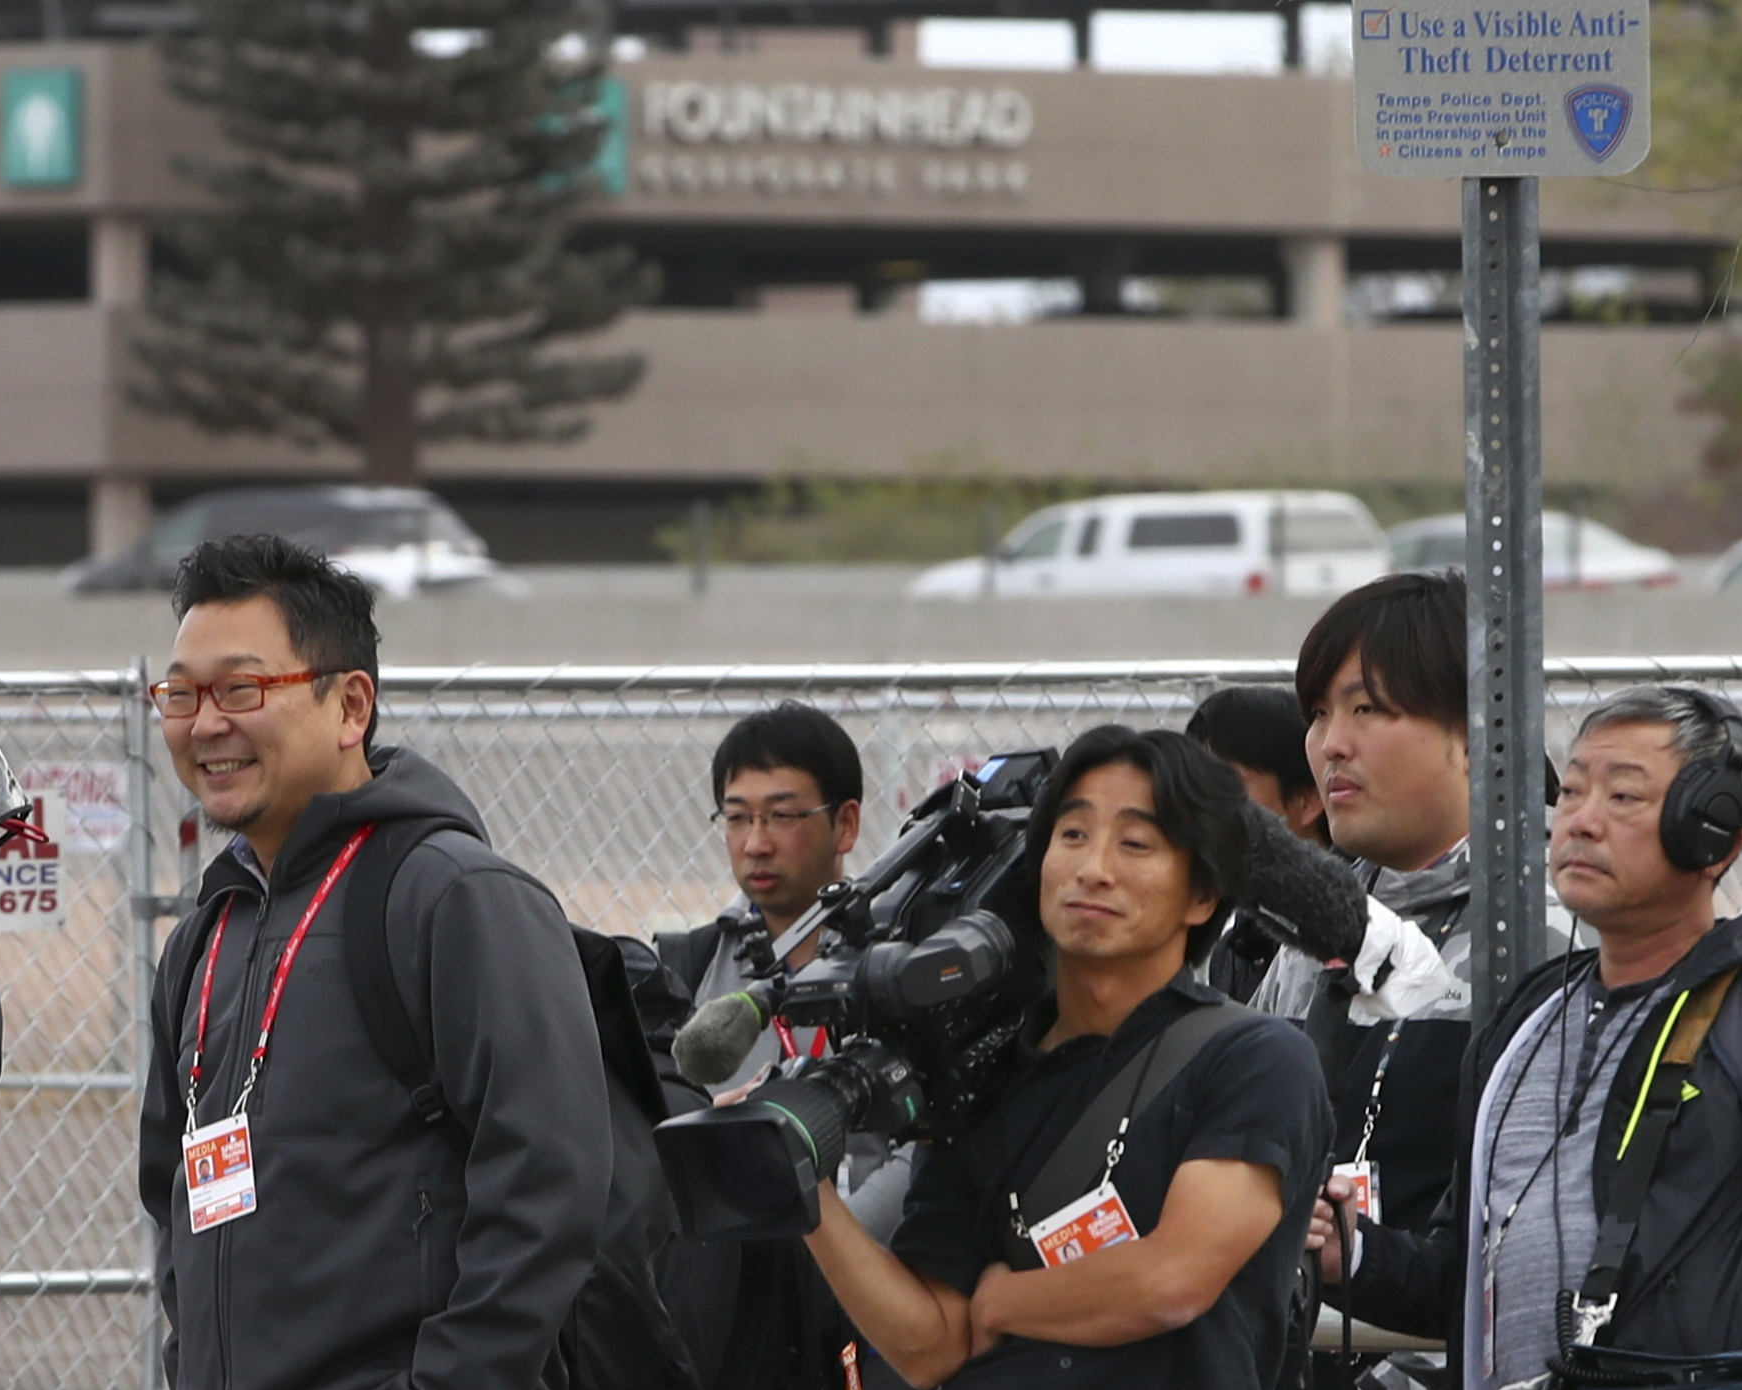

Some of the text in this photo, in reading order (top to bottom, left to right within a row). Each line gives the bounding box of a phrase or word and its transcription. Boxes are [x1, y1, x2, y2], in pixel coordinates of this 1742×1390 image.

[1401, 10, 1640, 38] Use a Visible Anti-
[1399, 47, 1613, 74] Theft Deterrent
[1376, 92, 1547, 108] Tempe Police Dept.
[1573, 93, 1622, 111] POLICE
[1376, 109, 1547, 124] Crime Prevention Unit
[1376, 127, 1390, 140] in
[1394, 126, 1482, 143] partnership
[1523, 126, 1547, 139] the
[1398, 144, 1463, 158] Citizens
[1471, 144, 1486, 158] of
[188, 1141, 218, 1160] MEDIA
[1042, 1222, 1082, 1251] MEDIA
